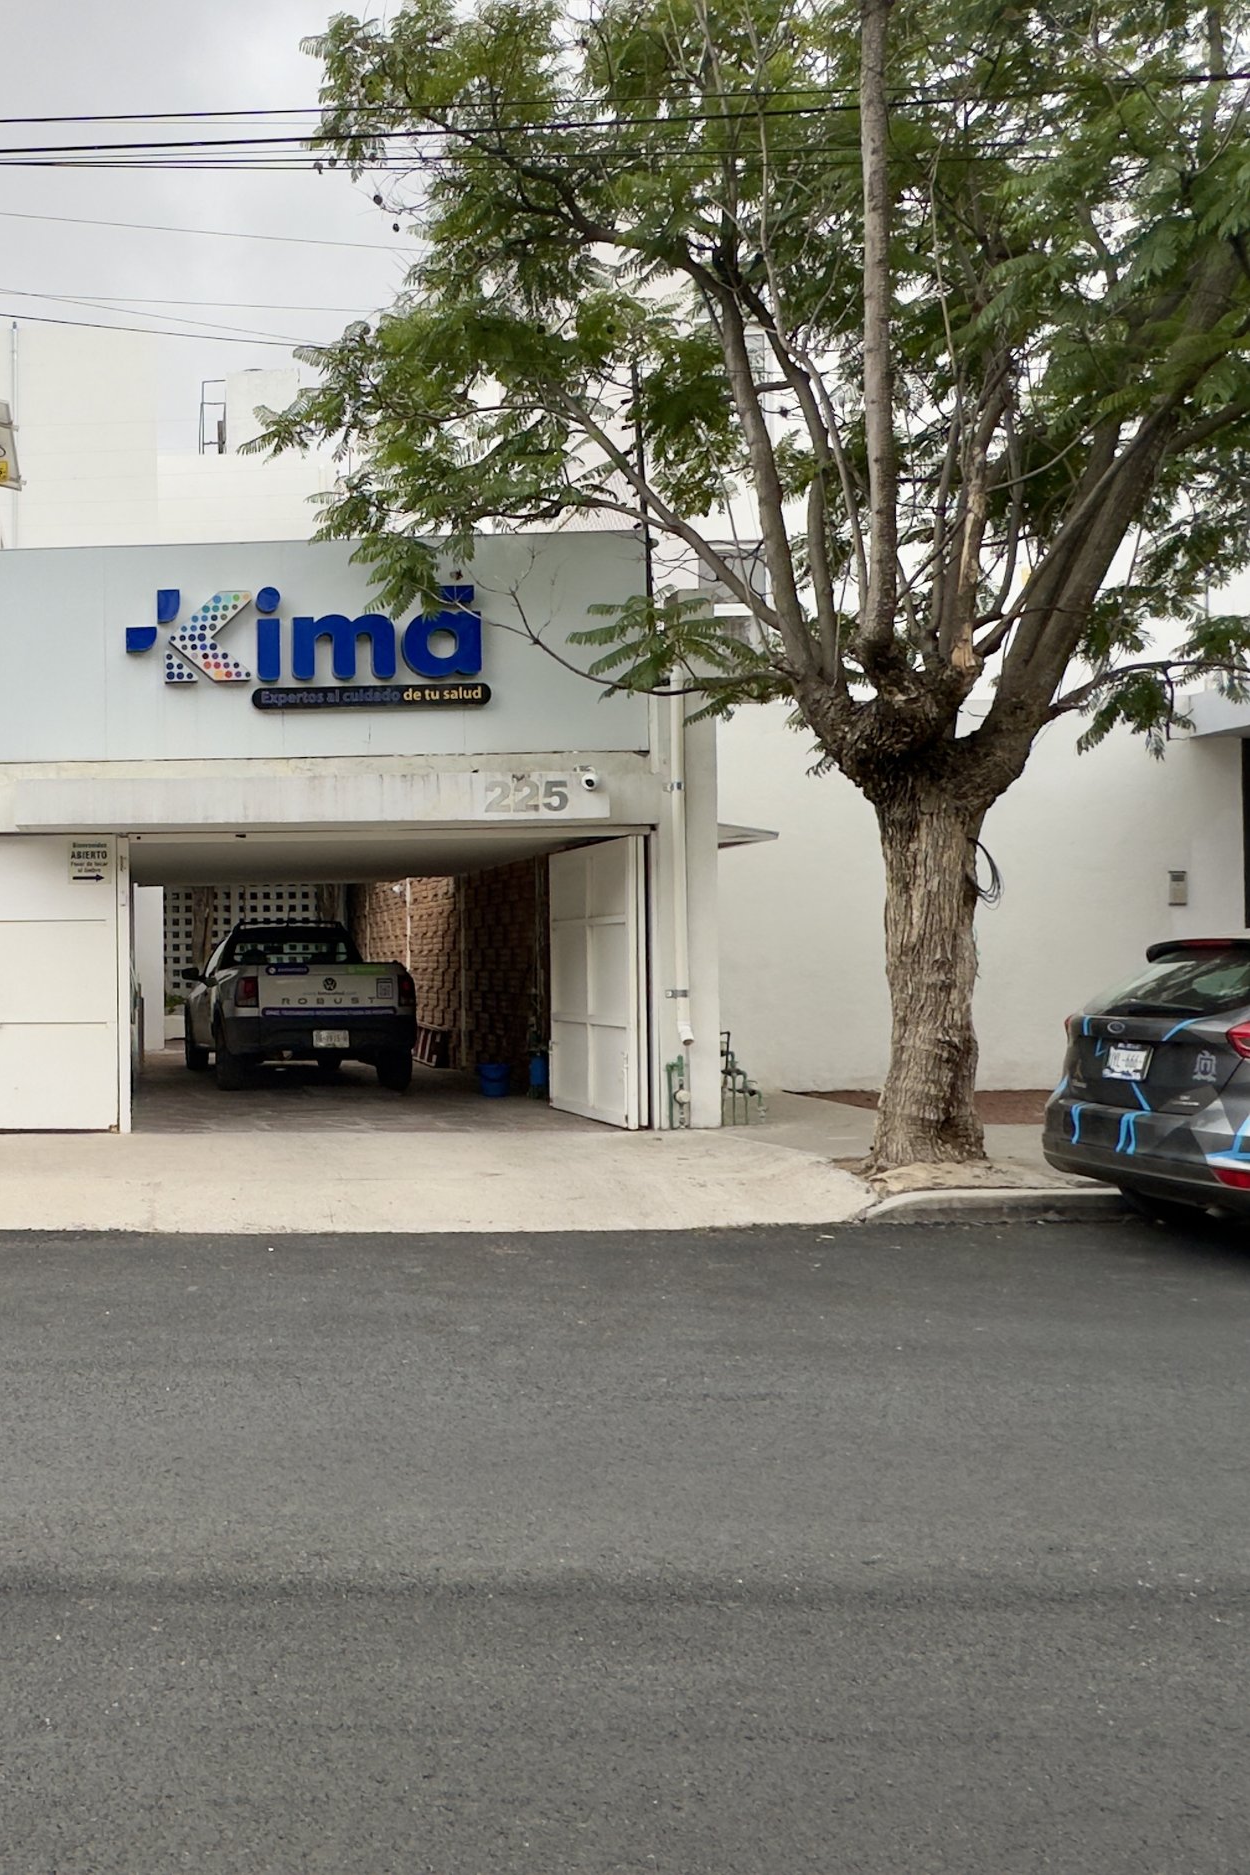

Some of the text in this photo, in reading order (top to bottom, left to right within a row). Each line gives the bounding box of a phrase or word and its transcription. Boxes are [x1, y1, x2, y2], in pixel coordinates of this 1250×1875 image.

[261, 685, 483, 706] Expertos al cuidado de tu salud
[484, 780, 569, 813] 225
[71, 851, 107, 859] ABIERTO
[281, 996, 376, 1005] ROBUST
